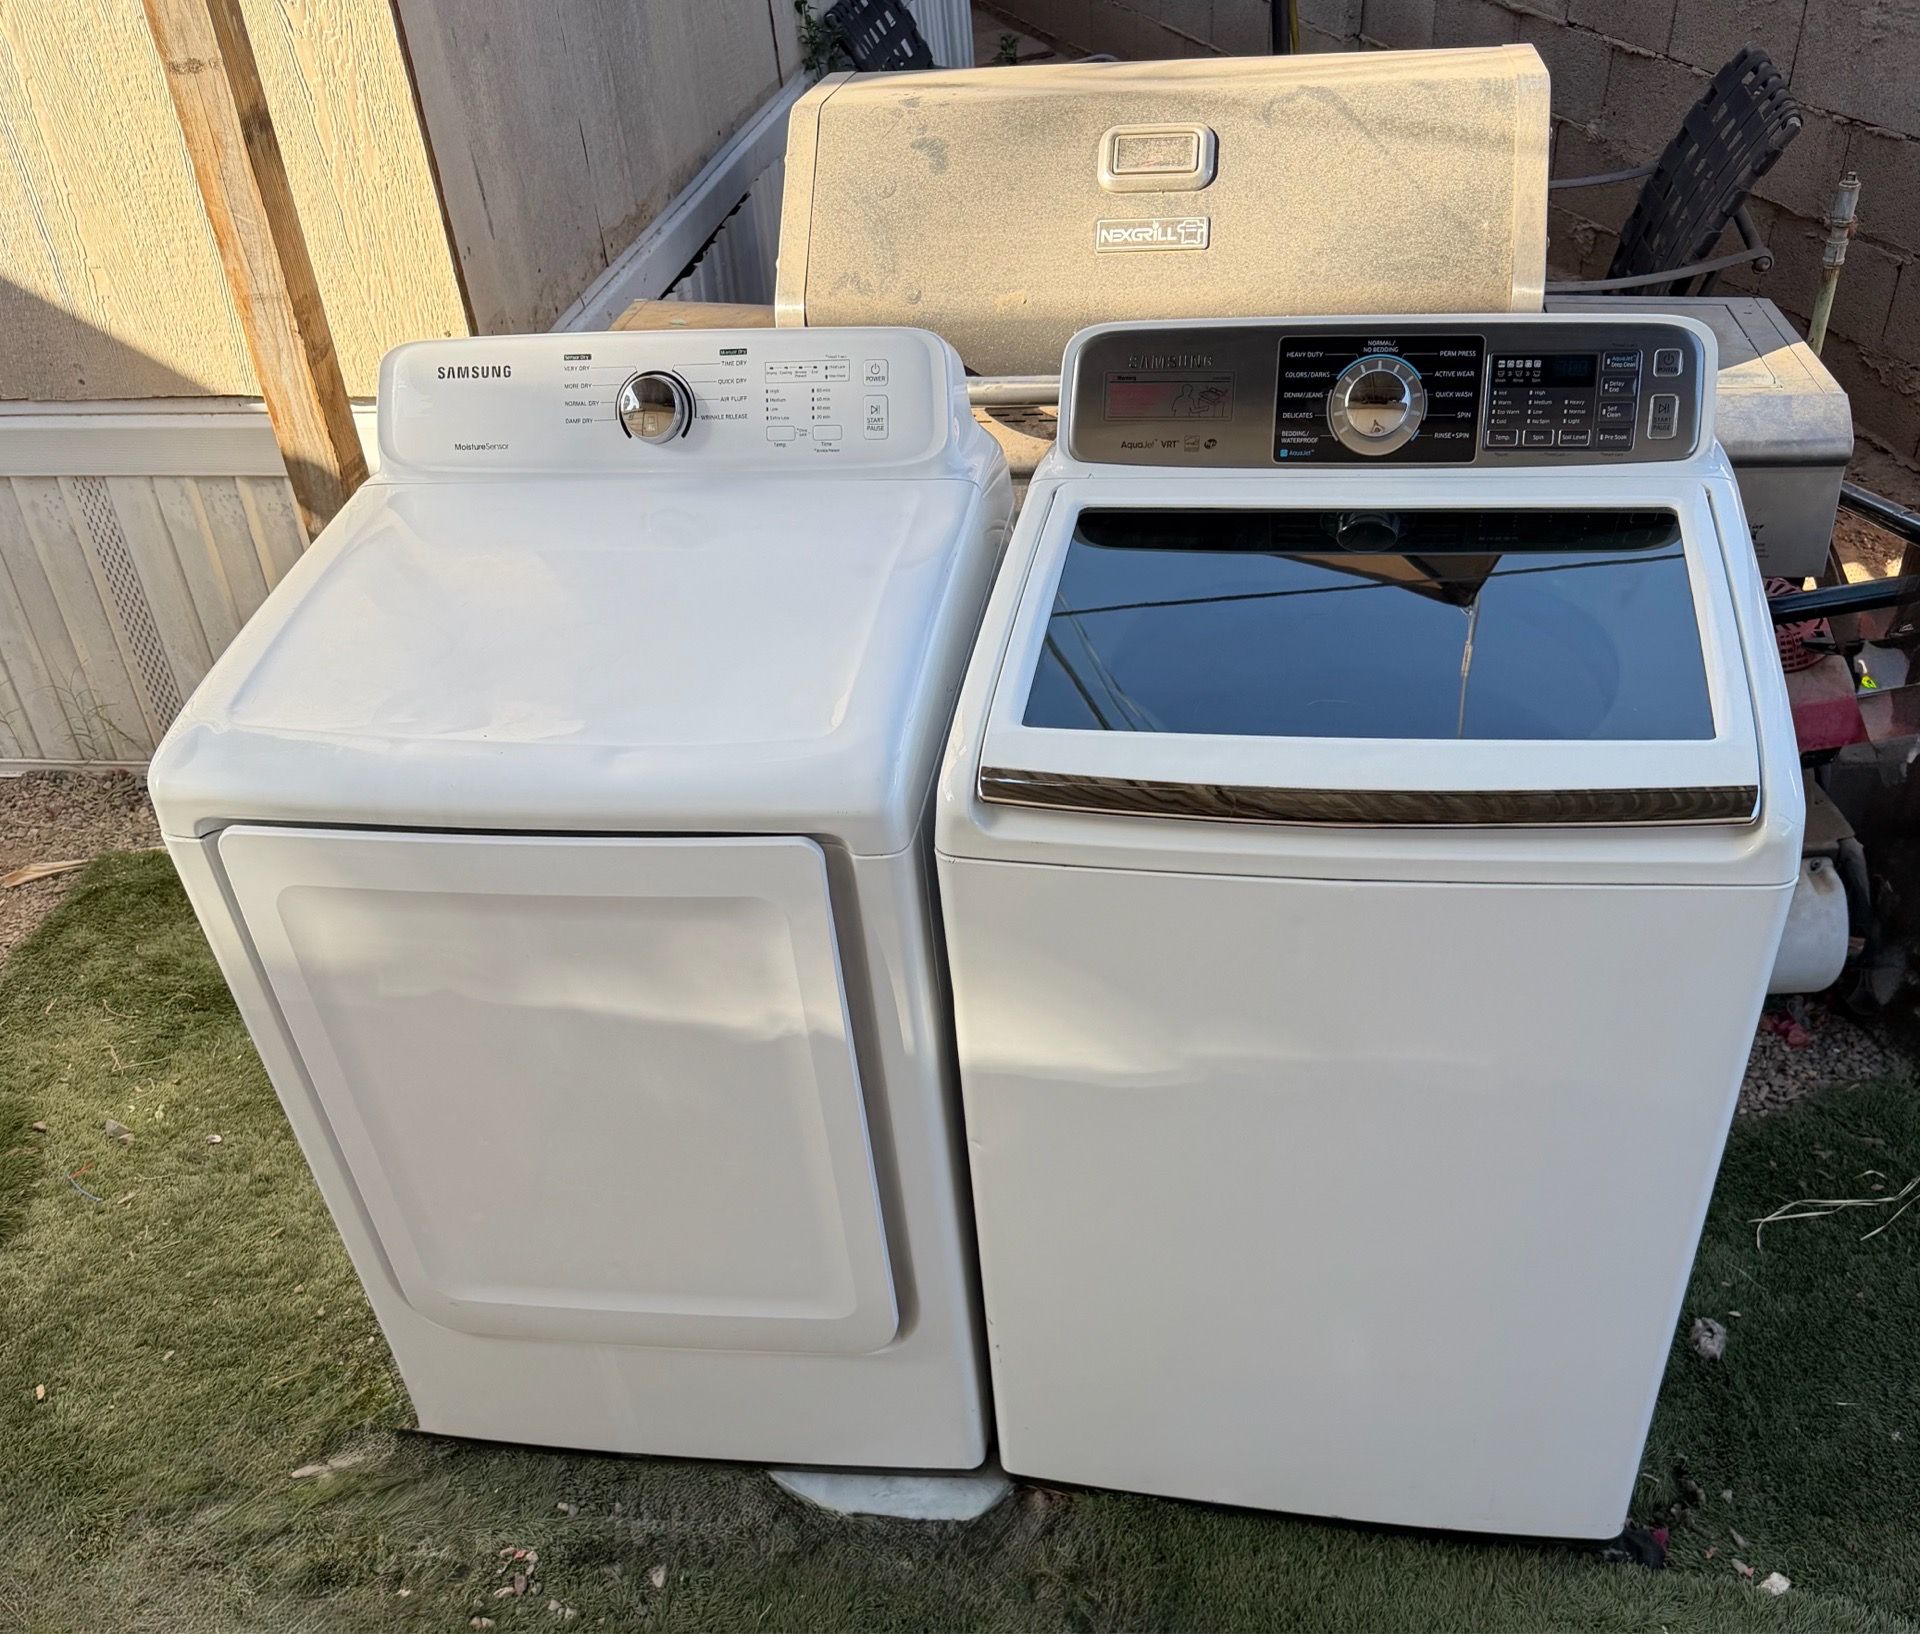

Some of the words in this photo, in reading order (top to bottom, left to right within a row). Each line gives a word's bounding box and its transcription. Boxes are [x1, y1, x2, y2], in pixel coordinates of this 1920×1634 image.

[1100, 224, 1177, 242] NEXGRILL
[1128, 354, 1213, 369] SAMSUNG
[437, 365, 512, 379] SAMSUNG
